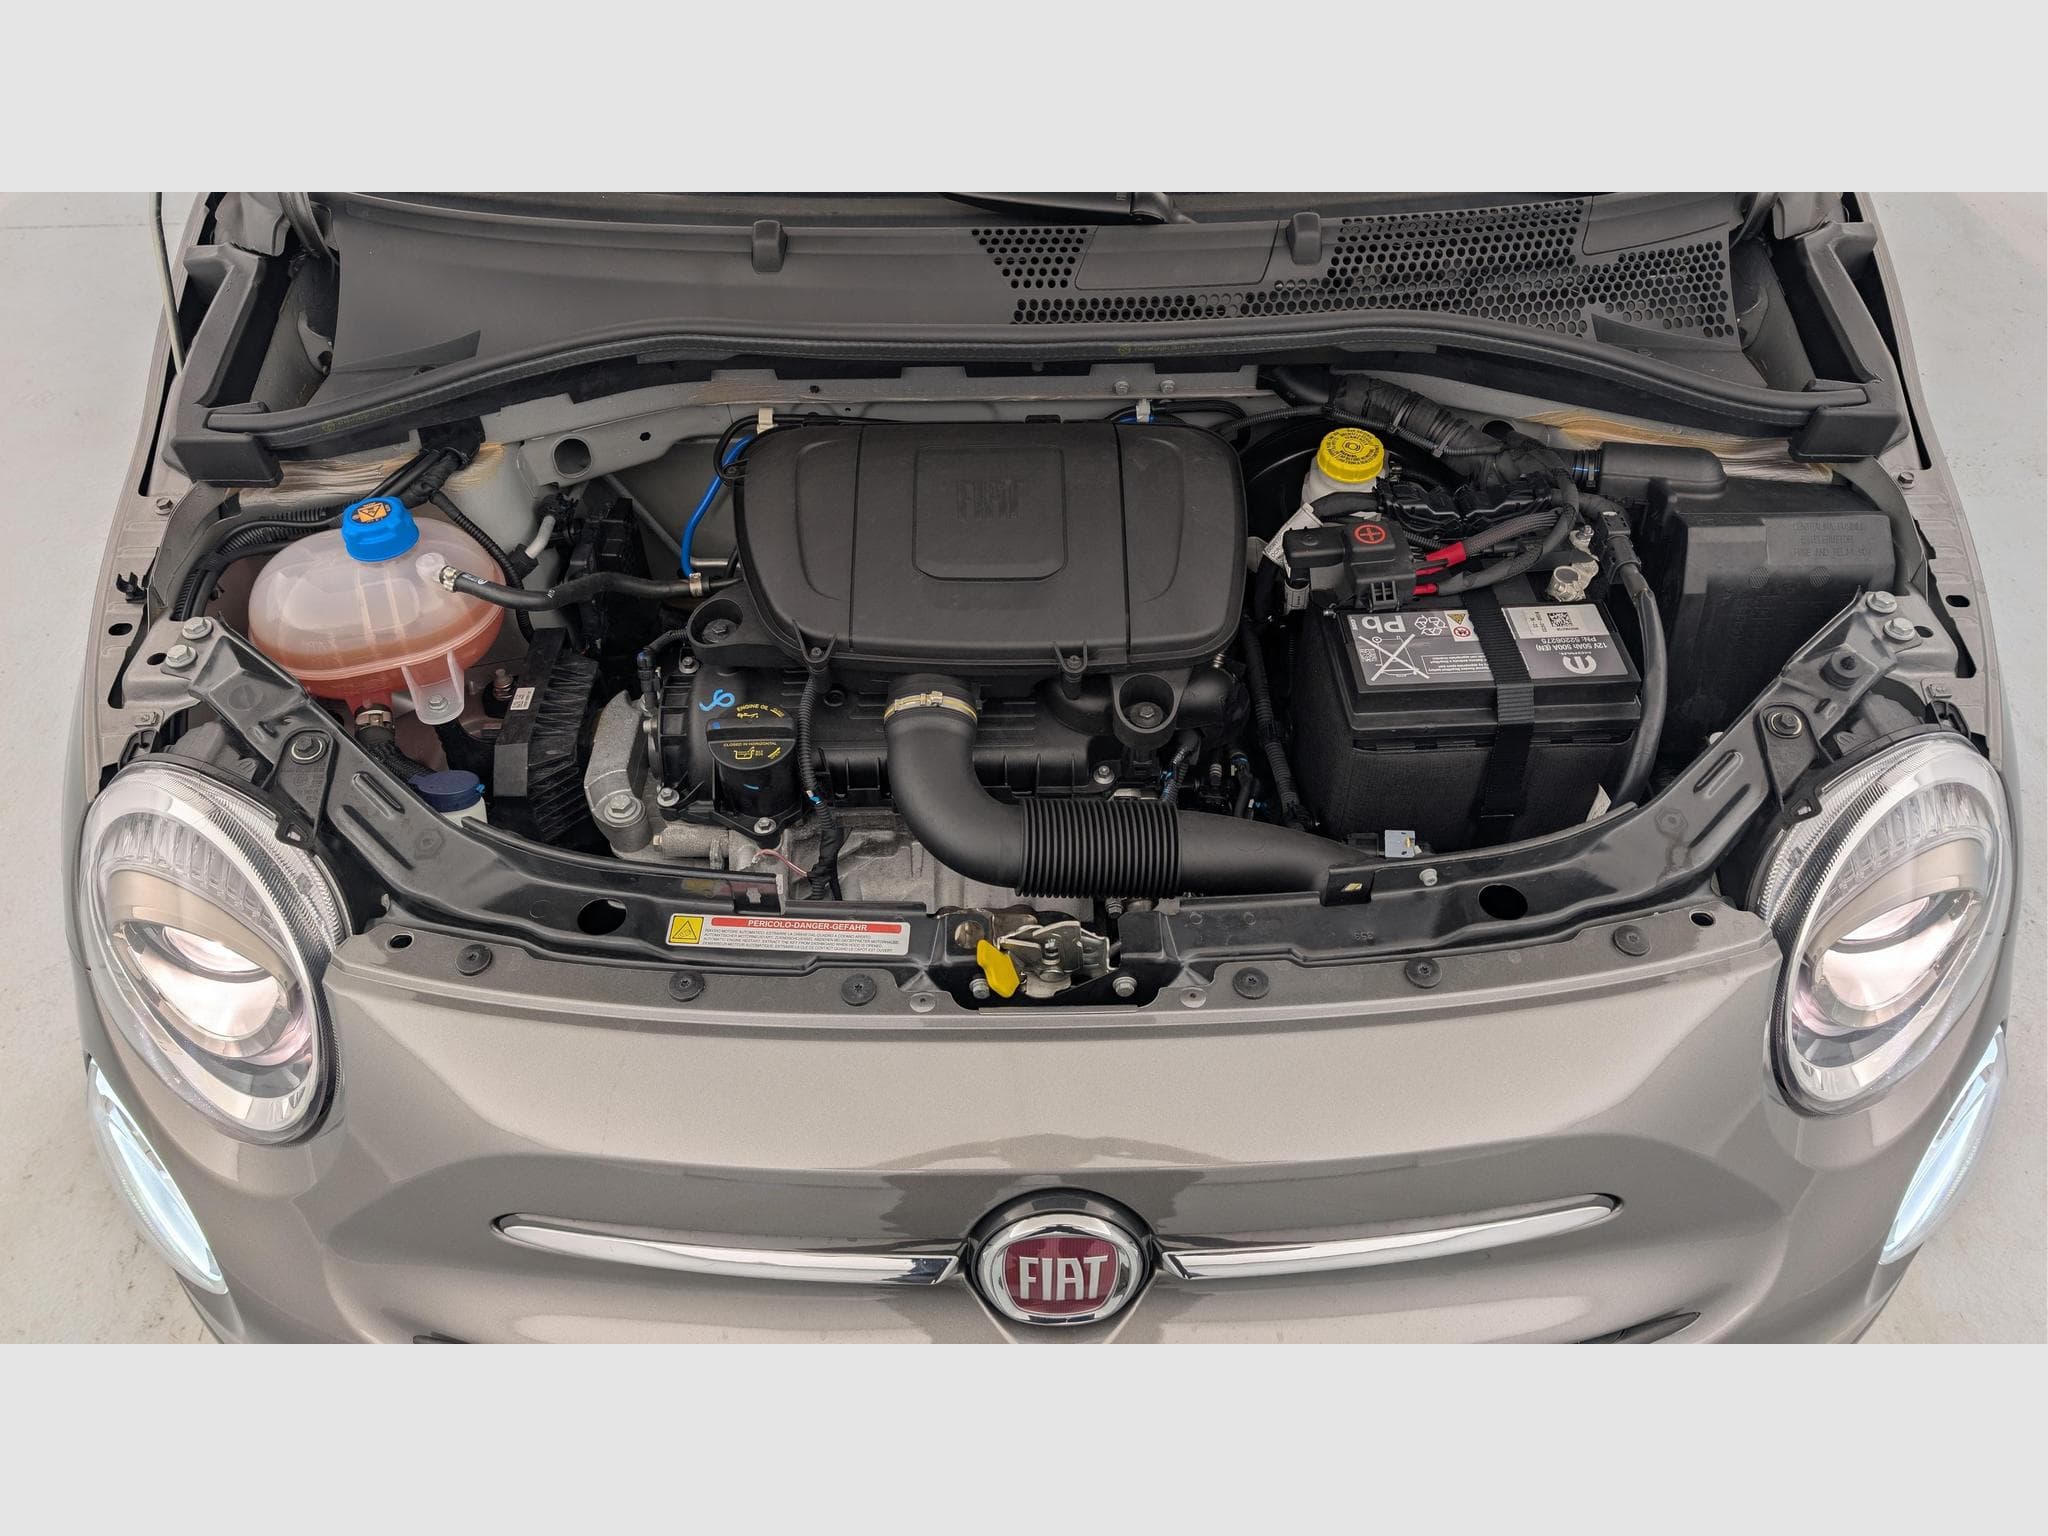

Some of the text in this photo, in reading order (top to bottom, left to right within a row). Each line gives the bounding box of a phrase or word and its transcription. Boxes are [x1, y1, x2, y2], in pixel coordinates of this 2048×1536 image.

[1361, 615, 1406, 634] Pb
[1553, 643, 1571, 651] 500A
[1573, 642, 1591, 650] 50Ah
[1594, 641, 1607, 649] 12V
[736, 703, 759, 712] ENGINE
[748, 919, 867, 931] PERICOLO-DANGER-GEFAHR
[1018, 1255, 1109, 1301] FIAT
